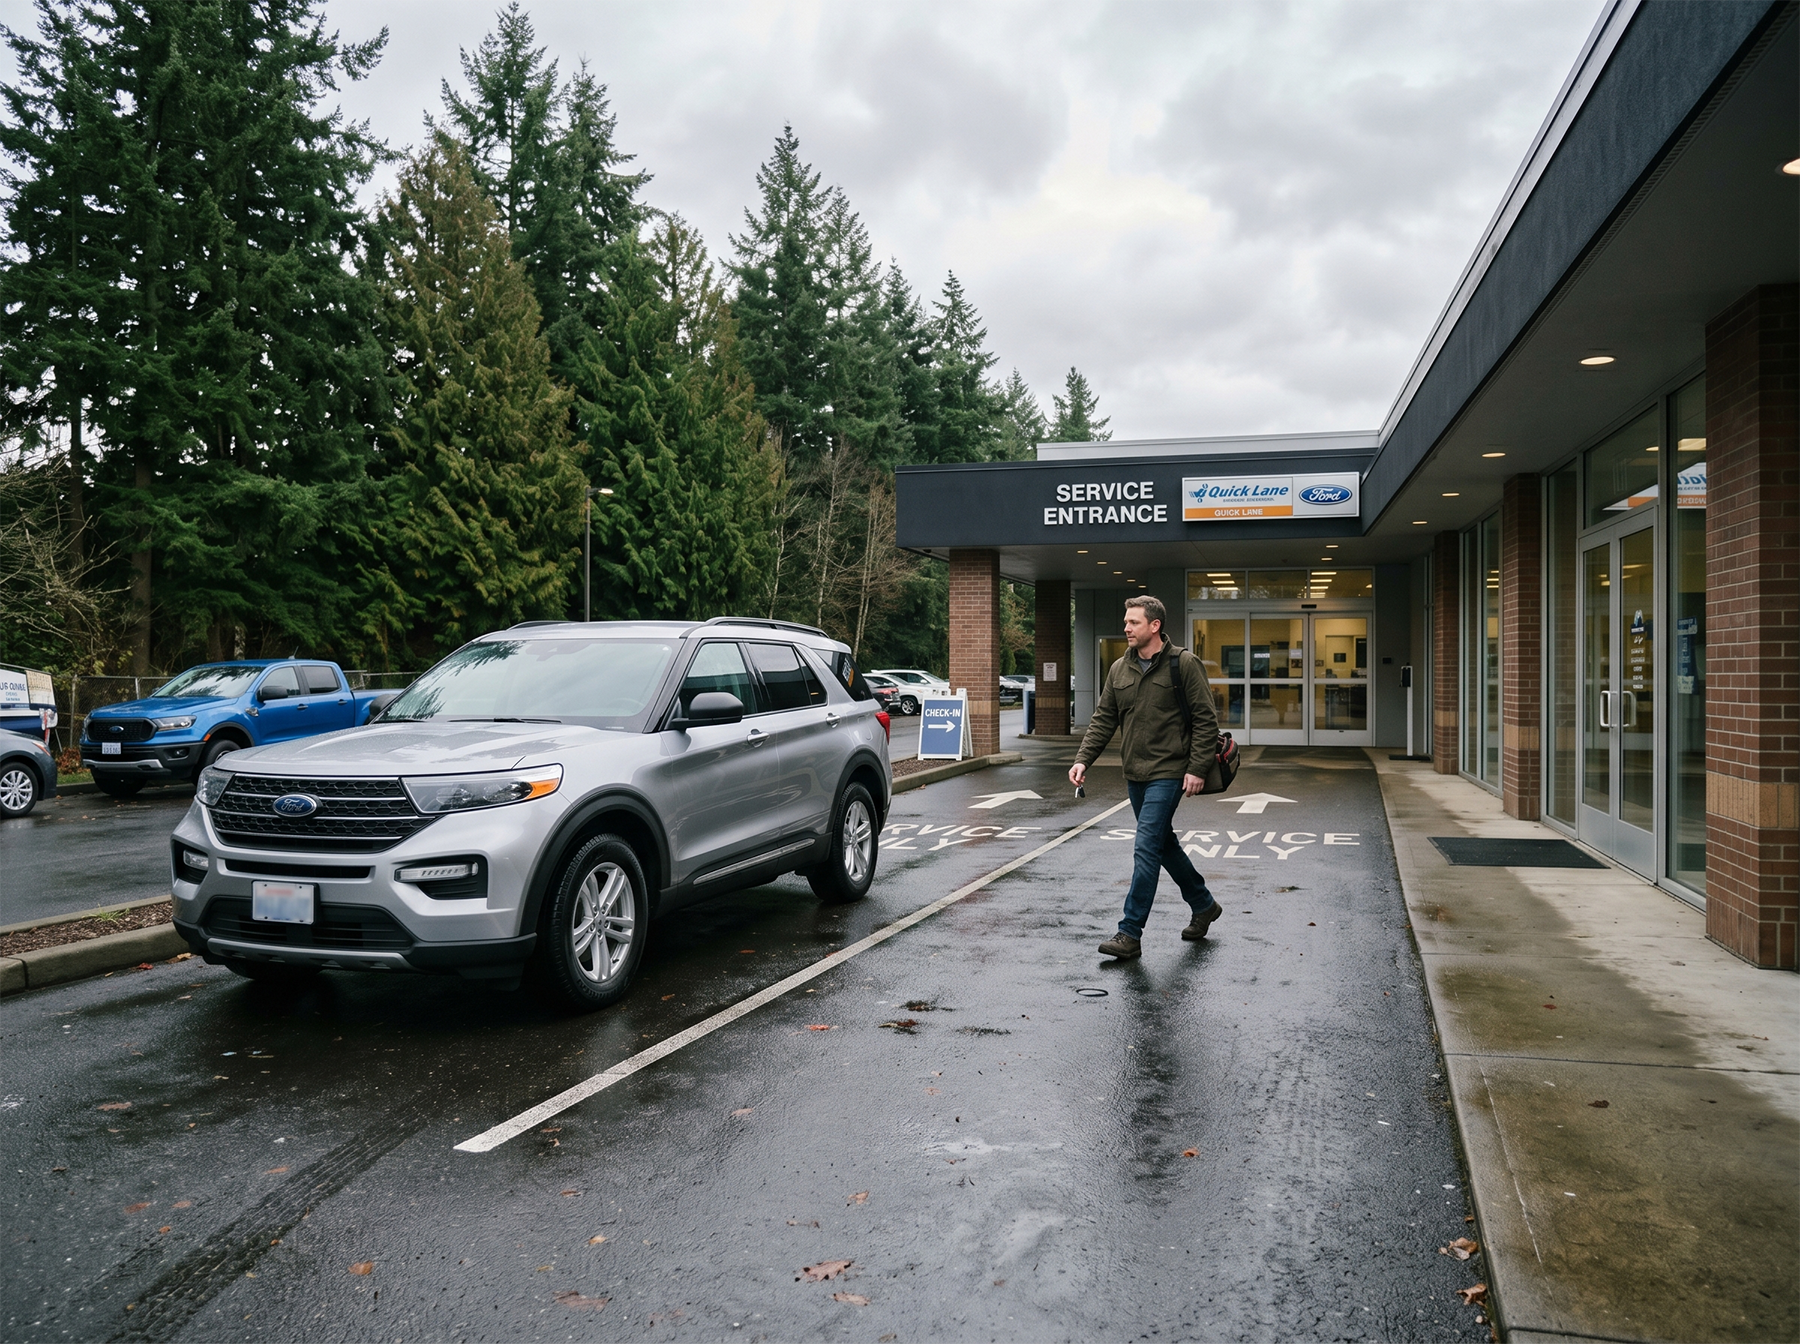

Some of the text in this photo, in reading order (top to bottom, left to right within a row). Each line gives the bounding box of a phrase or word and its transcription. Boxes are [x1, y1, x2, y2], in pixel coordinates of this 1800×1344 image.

[1056, 481, 1154, 502] SERVICE
[1208, 485, 1289, 498] Quick Lane
[1309, 487, 1342, 501] Ford
[1044, 504, 1168, 525] ENTRANCE
[1242, 508, 1263, 516] LANE
[925, 708, 961, 717] CHECK-IN
[281, 798, 305, 811] Ford
[882, 822, 1042, 839] RVICE
[1100, 829, 1360, 845] SRVICE
[1183, 844, 1304, 860] NLY
